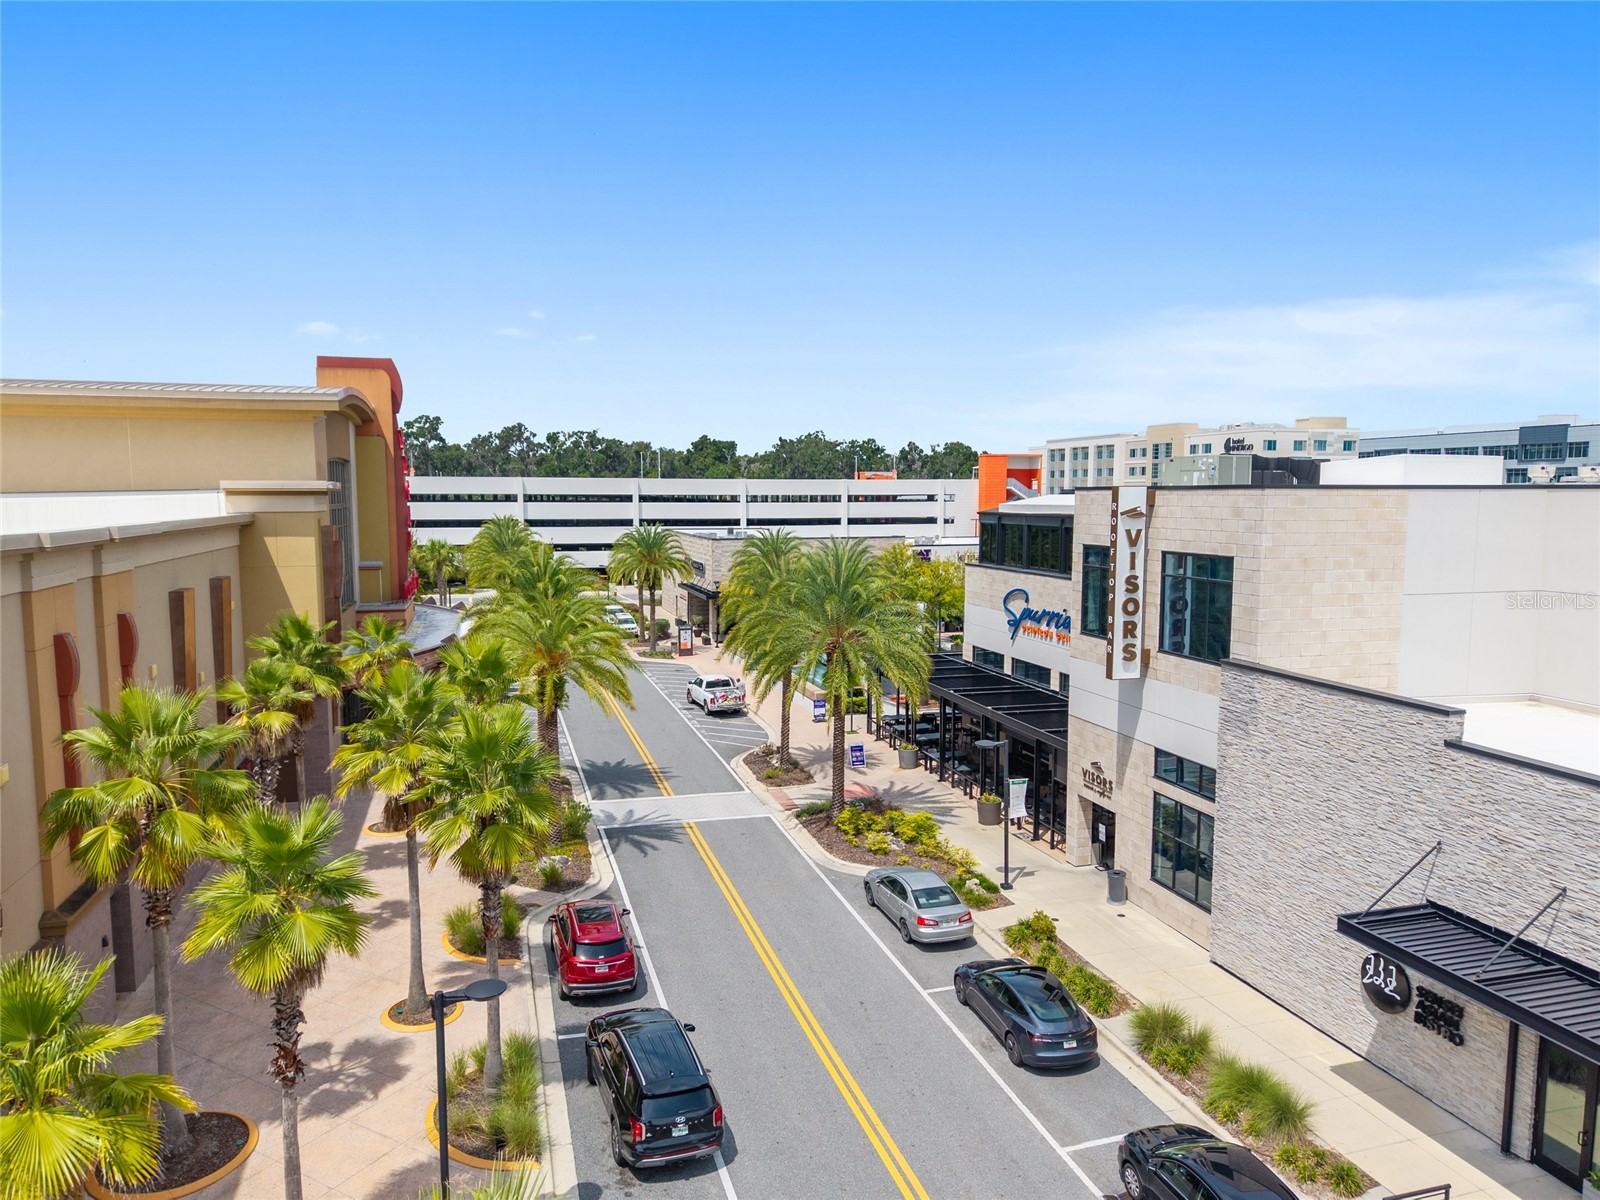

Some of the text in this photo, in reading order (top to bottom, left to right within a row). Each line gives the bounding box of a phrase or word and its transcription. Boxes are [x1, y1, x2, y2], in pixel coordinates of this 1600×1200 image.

[1109, 502, 1117, 601] ROOFTOP
[1122, 528, 1143, 662] VISORS
[1082, 767, 1113, 792] VISORS
[1413, 1010, 1465, 1047] BISTRO
